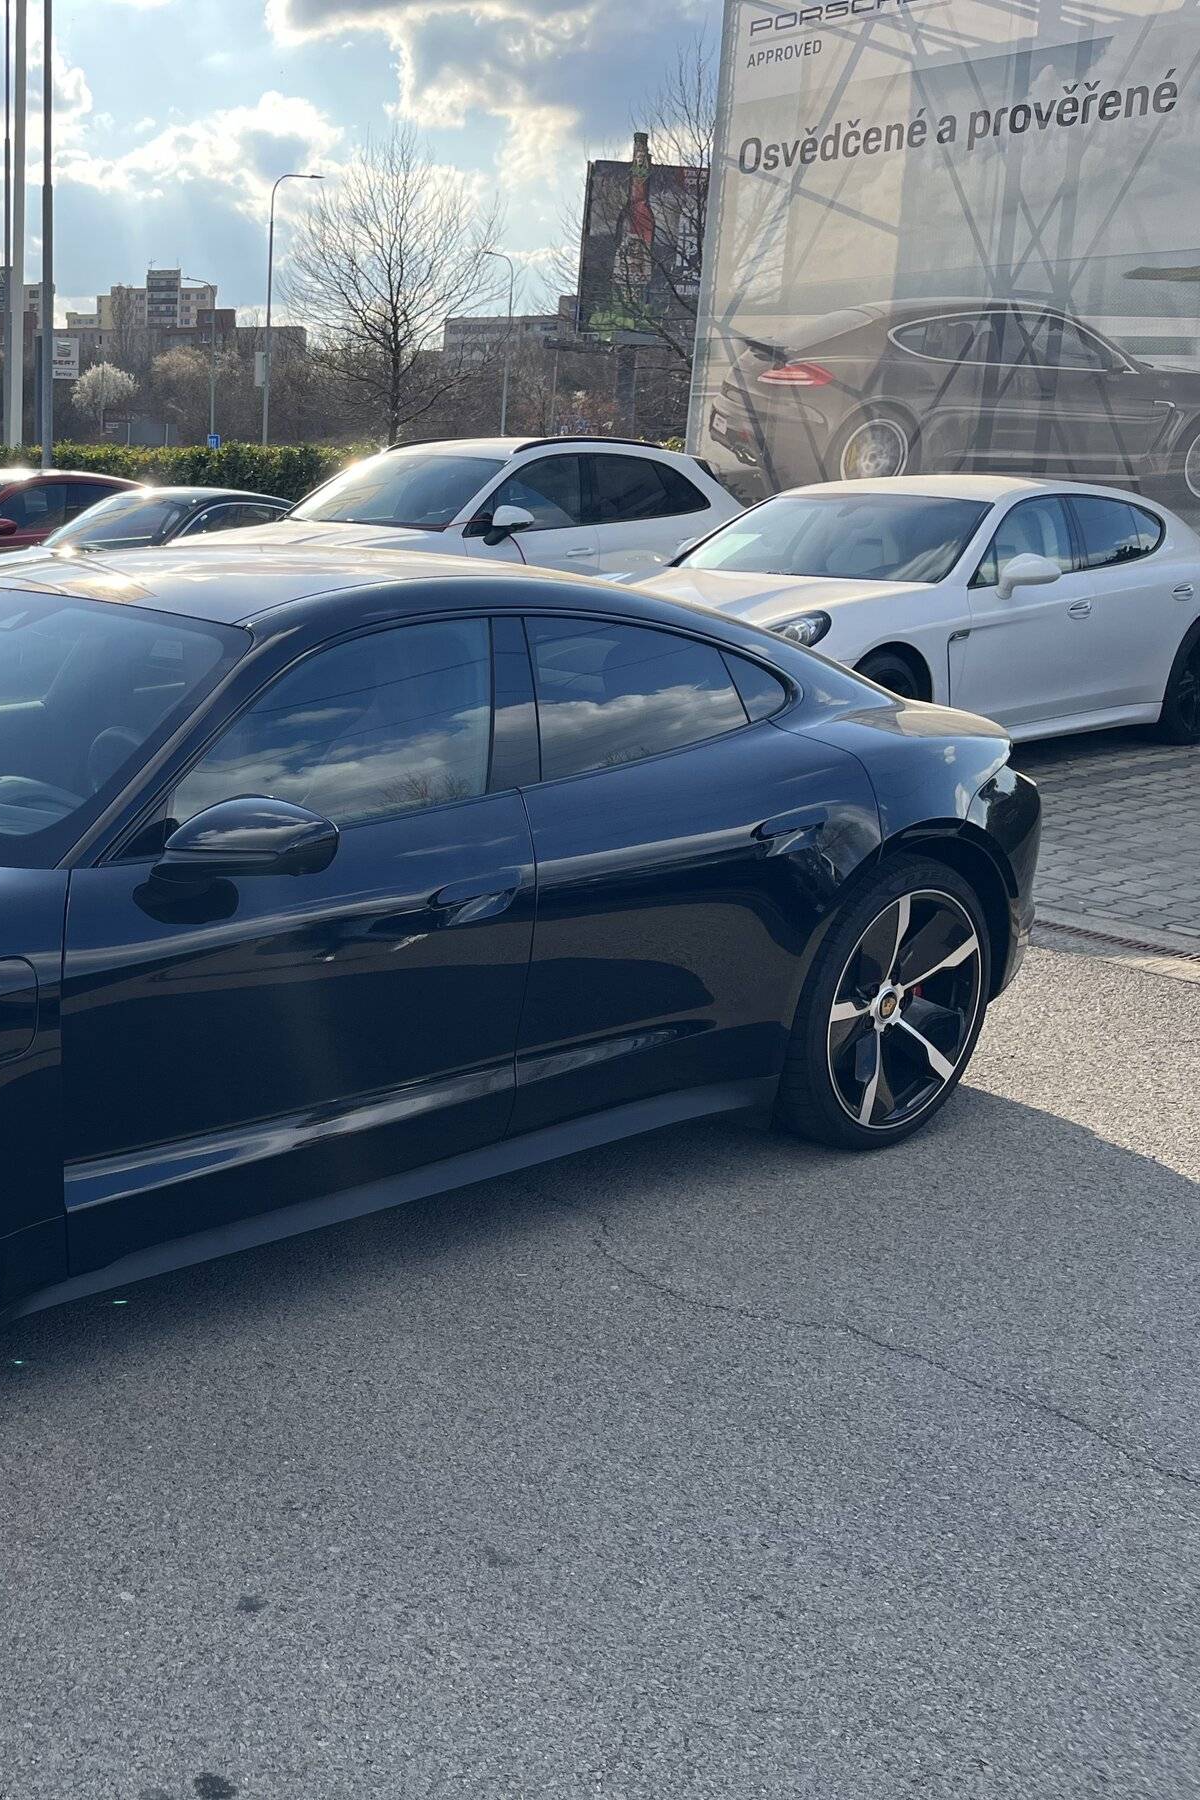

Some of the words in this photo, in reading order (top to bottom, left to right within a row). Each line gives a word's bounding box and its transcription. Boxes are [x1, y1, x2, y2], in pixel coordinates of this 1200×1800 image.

[749, 0, 918, 37] PORSC
[747, 39, 822, 68] APPROVED
[739, 108, 927, 174] Osvědčené
[936, 114, 957, 144] a
[967, 68, 1178, 151] prověřené
